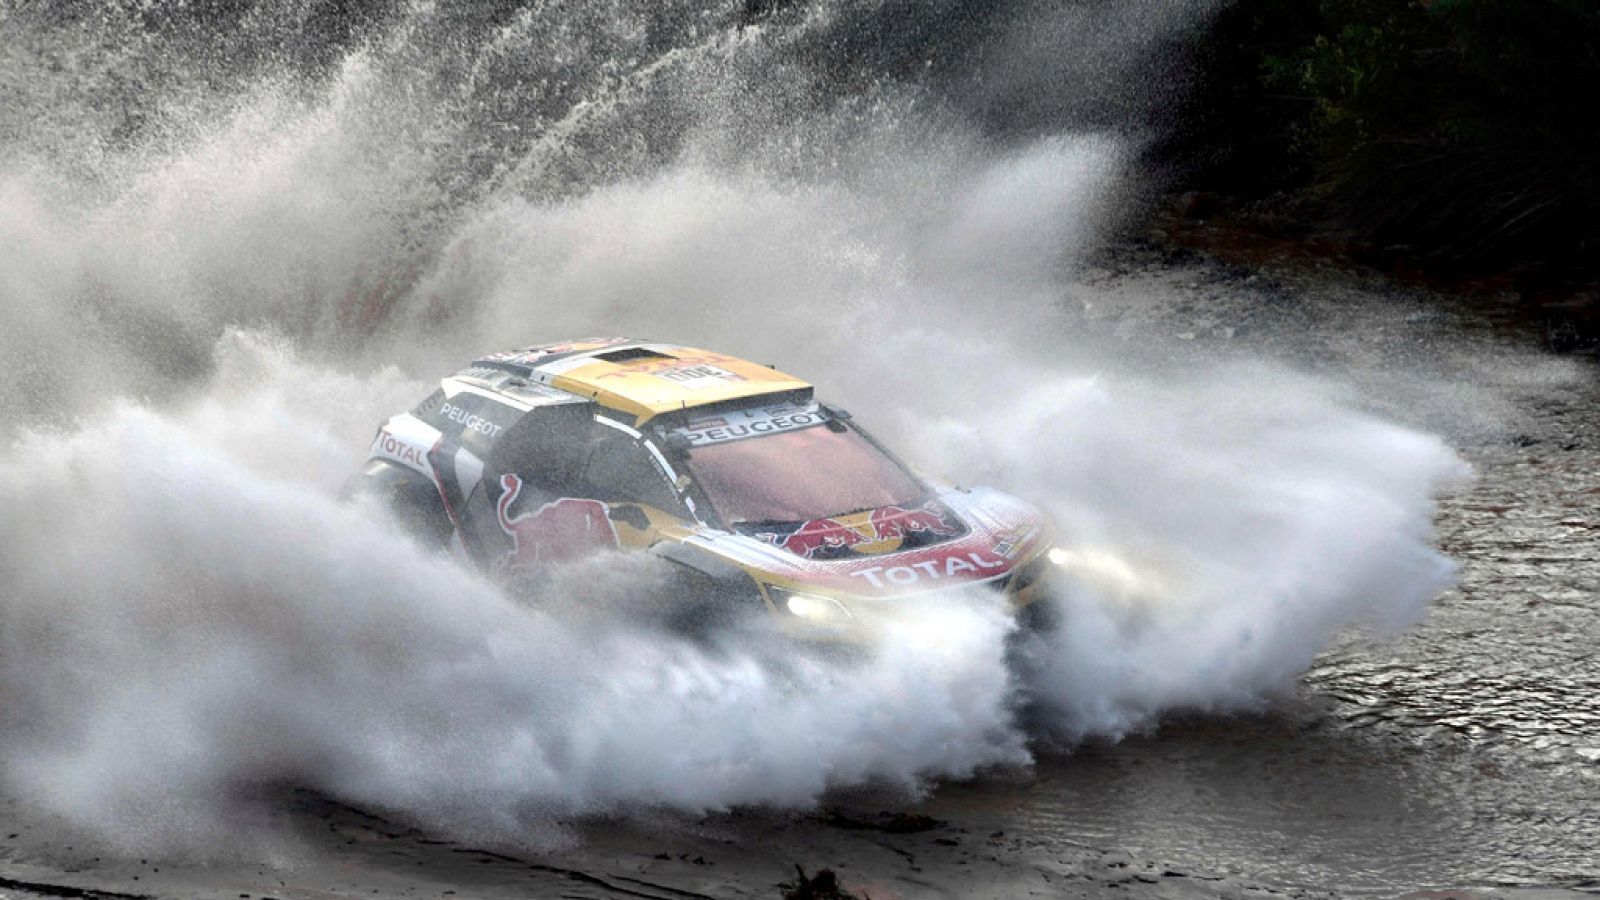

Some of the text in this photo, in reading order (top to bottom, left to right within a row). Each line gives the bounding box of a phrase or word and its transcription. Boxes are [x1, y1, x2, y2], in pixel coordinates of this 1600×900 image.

[440, 403, 502, 437] PEUGEOT
[380, 431, 423, 465] TOTAL
[851, 552, 1003, 589] TOTAL
